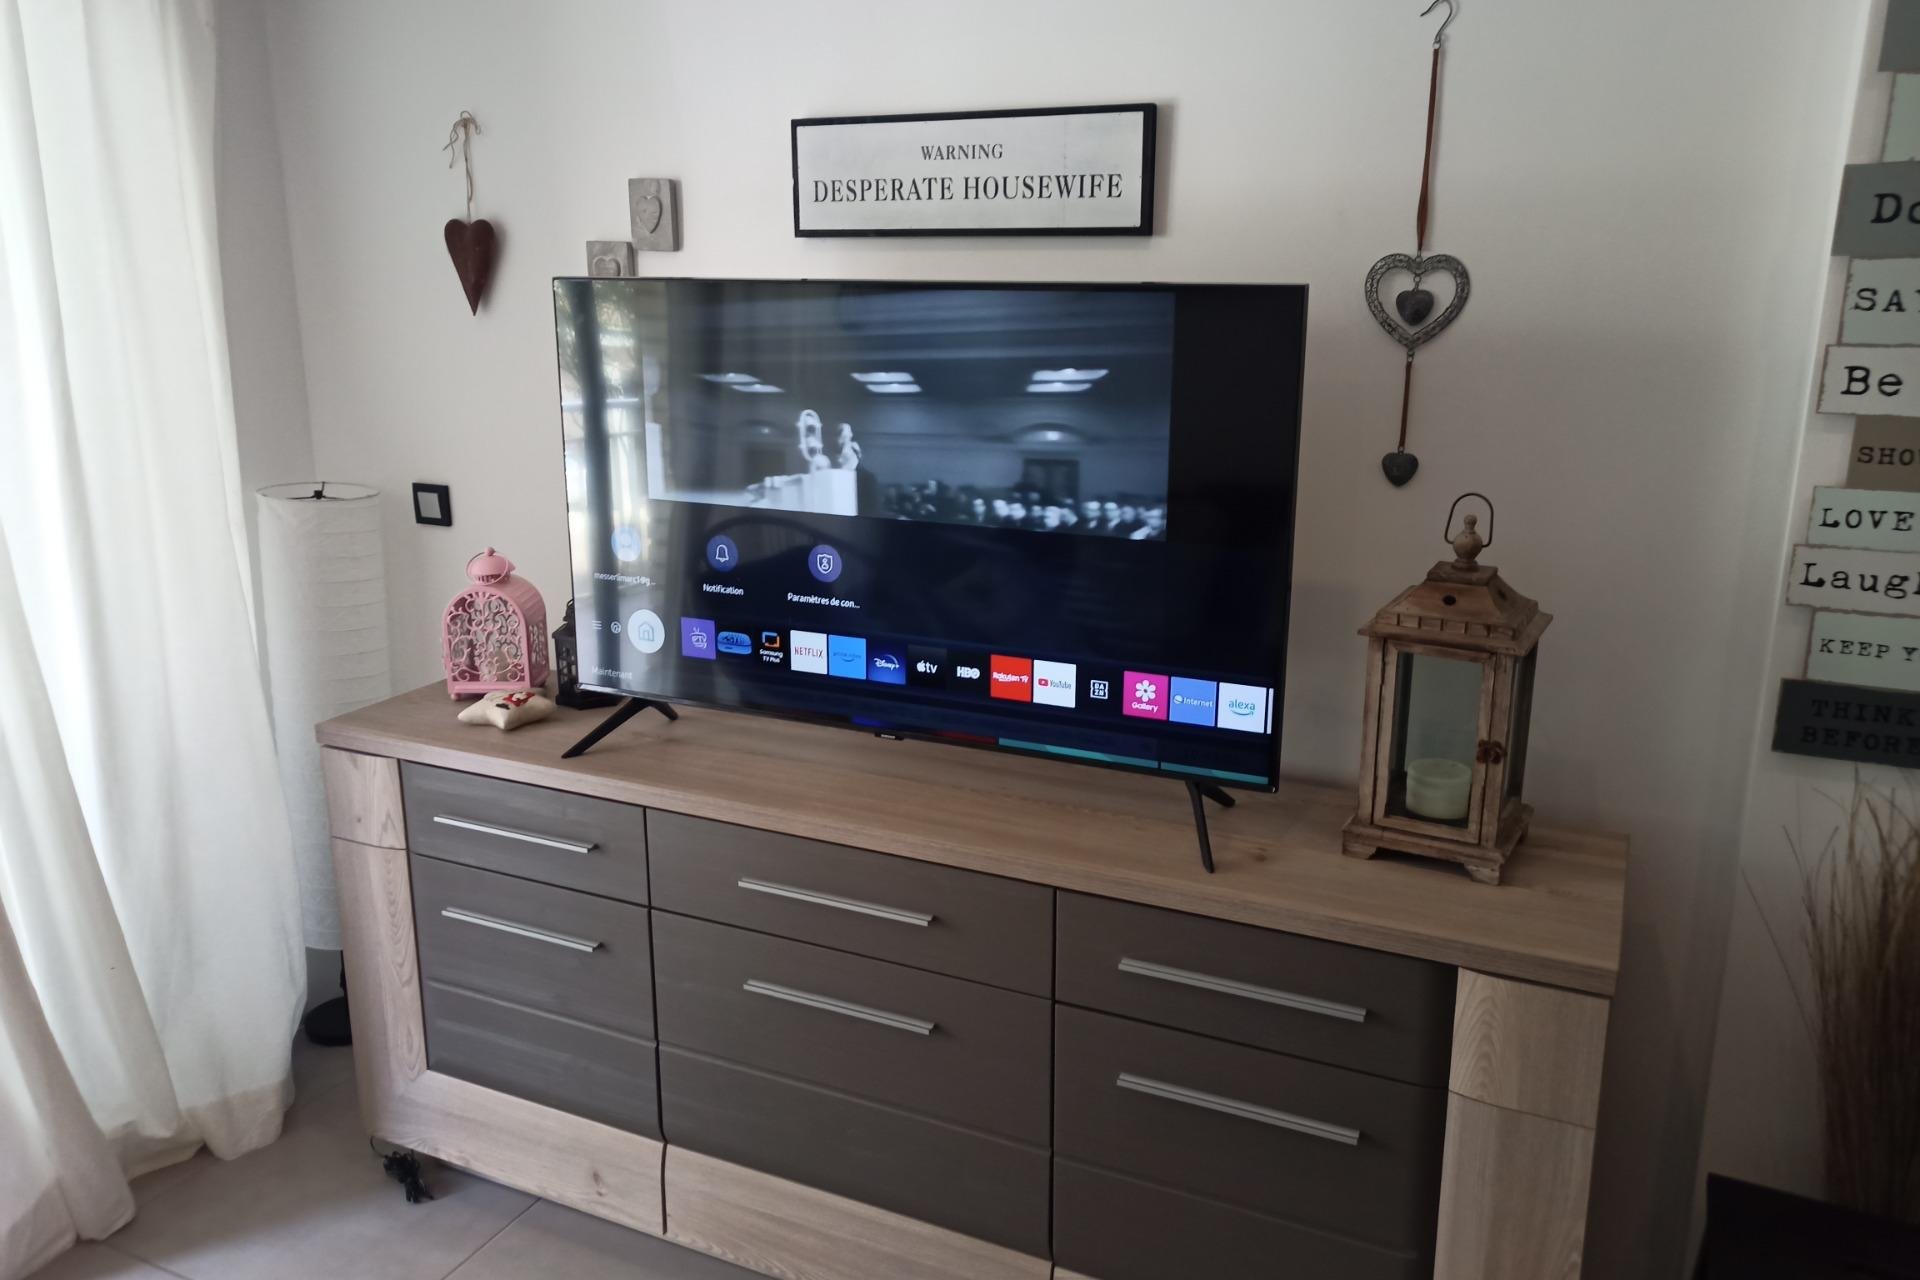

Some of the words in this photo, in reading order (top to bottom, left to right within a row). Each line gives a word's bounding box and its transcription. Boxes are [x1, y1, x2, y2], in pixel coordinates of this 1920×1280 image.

[921, 143, 1003, 161] WARNING
[812, 176, 954, 203] DESPERATE
[963, 173, 1123, 200] HOUSEWIFE
[1853, 287, 1920, 312] SA
[1840, 365, 1903, 396] Be
[1856, 446, 1920, 466] SHO
[1818, 507, 1914, 531] LOVE
[702, 583, 744, 596] Notification
[787, 592, 829, 606] Paramètres
[830, 597, 840, 607] de
[759, 649, 784, 659] Samsung
[794, 646, 824, 658] NETFLIX
[1819, 638, 1890, 658] KEEP
[591, 665, 633, 681] Maintenant
[926, 661, 938, 674] tv
[956, 665, 981, 680] HBO
[1049, 679, 1072, 690] YouTube
[1131, 701, 1159, 714] Gallery
[1183, 697, 1214, 708] Internet
[1228, 698, 1256, 712] alexa
[1811, 698, 1919, 728] THINK
[1801, 725, 1920, 756] BEFORE
